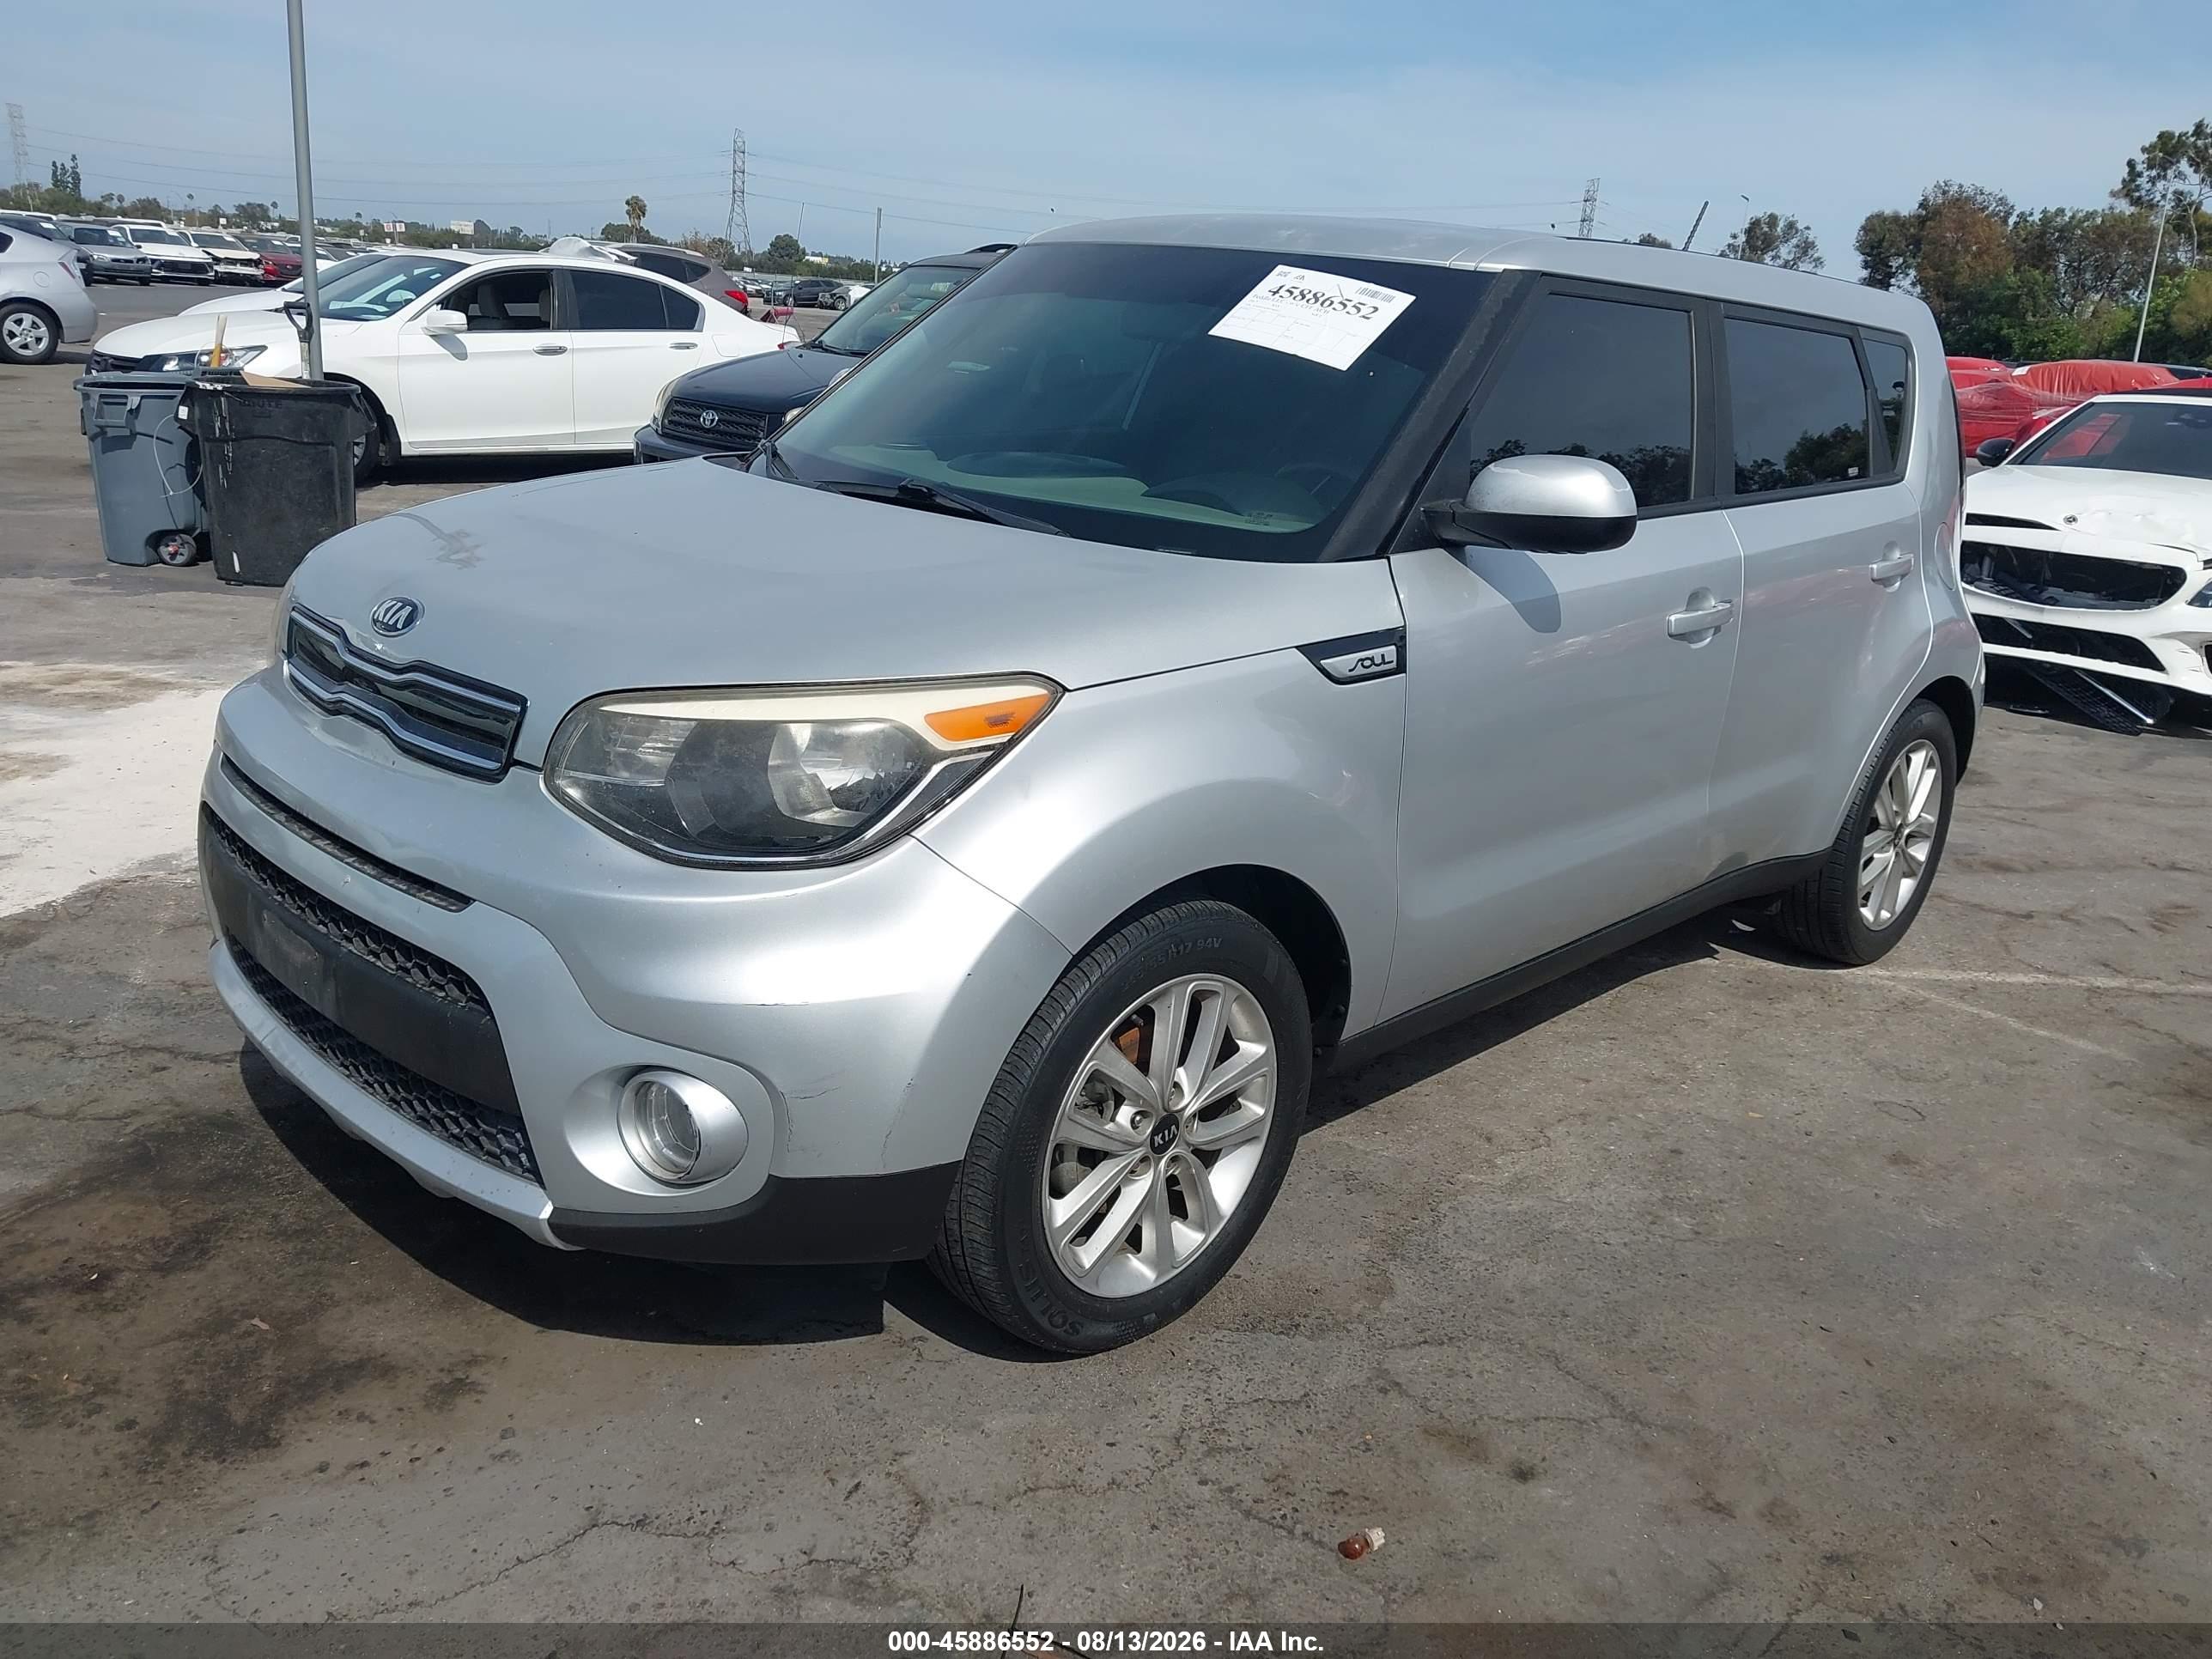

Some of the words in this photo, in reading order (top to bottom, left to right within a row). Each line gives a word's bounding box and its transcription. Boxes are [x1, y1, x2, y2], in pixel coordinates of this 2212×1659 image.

[1267, 283, 1379, 320] 45886552
[374, 599, 413, 629] KIA
[1347, 653, 1395, 672] SOUL
[1153, 1124, 1178, 1148] KIA
